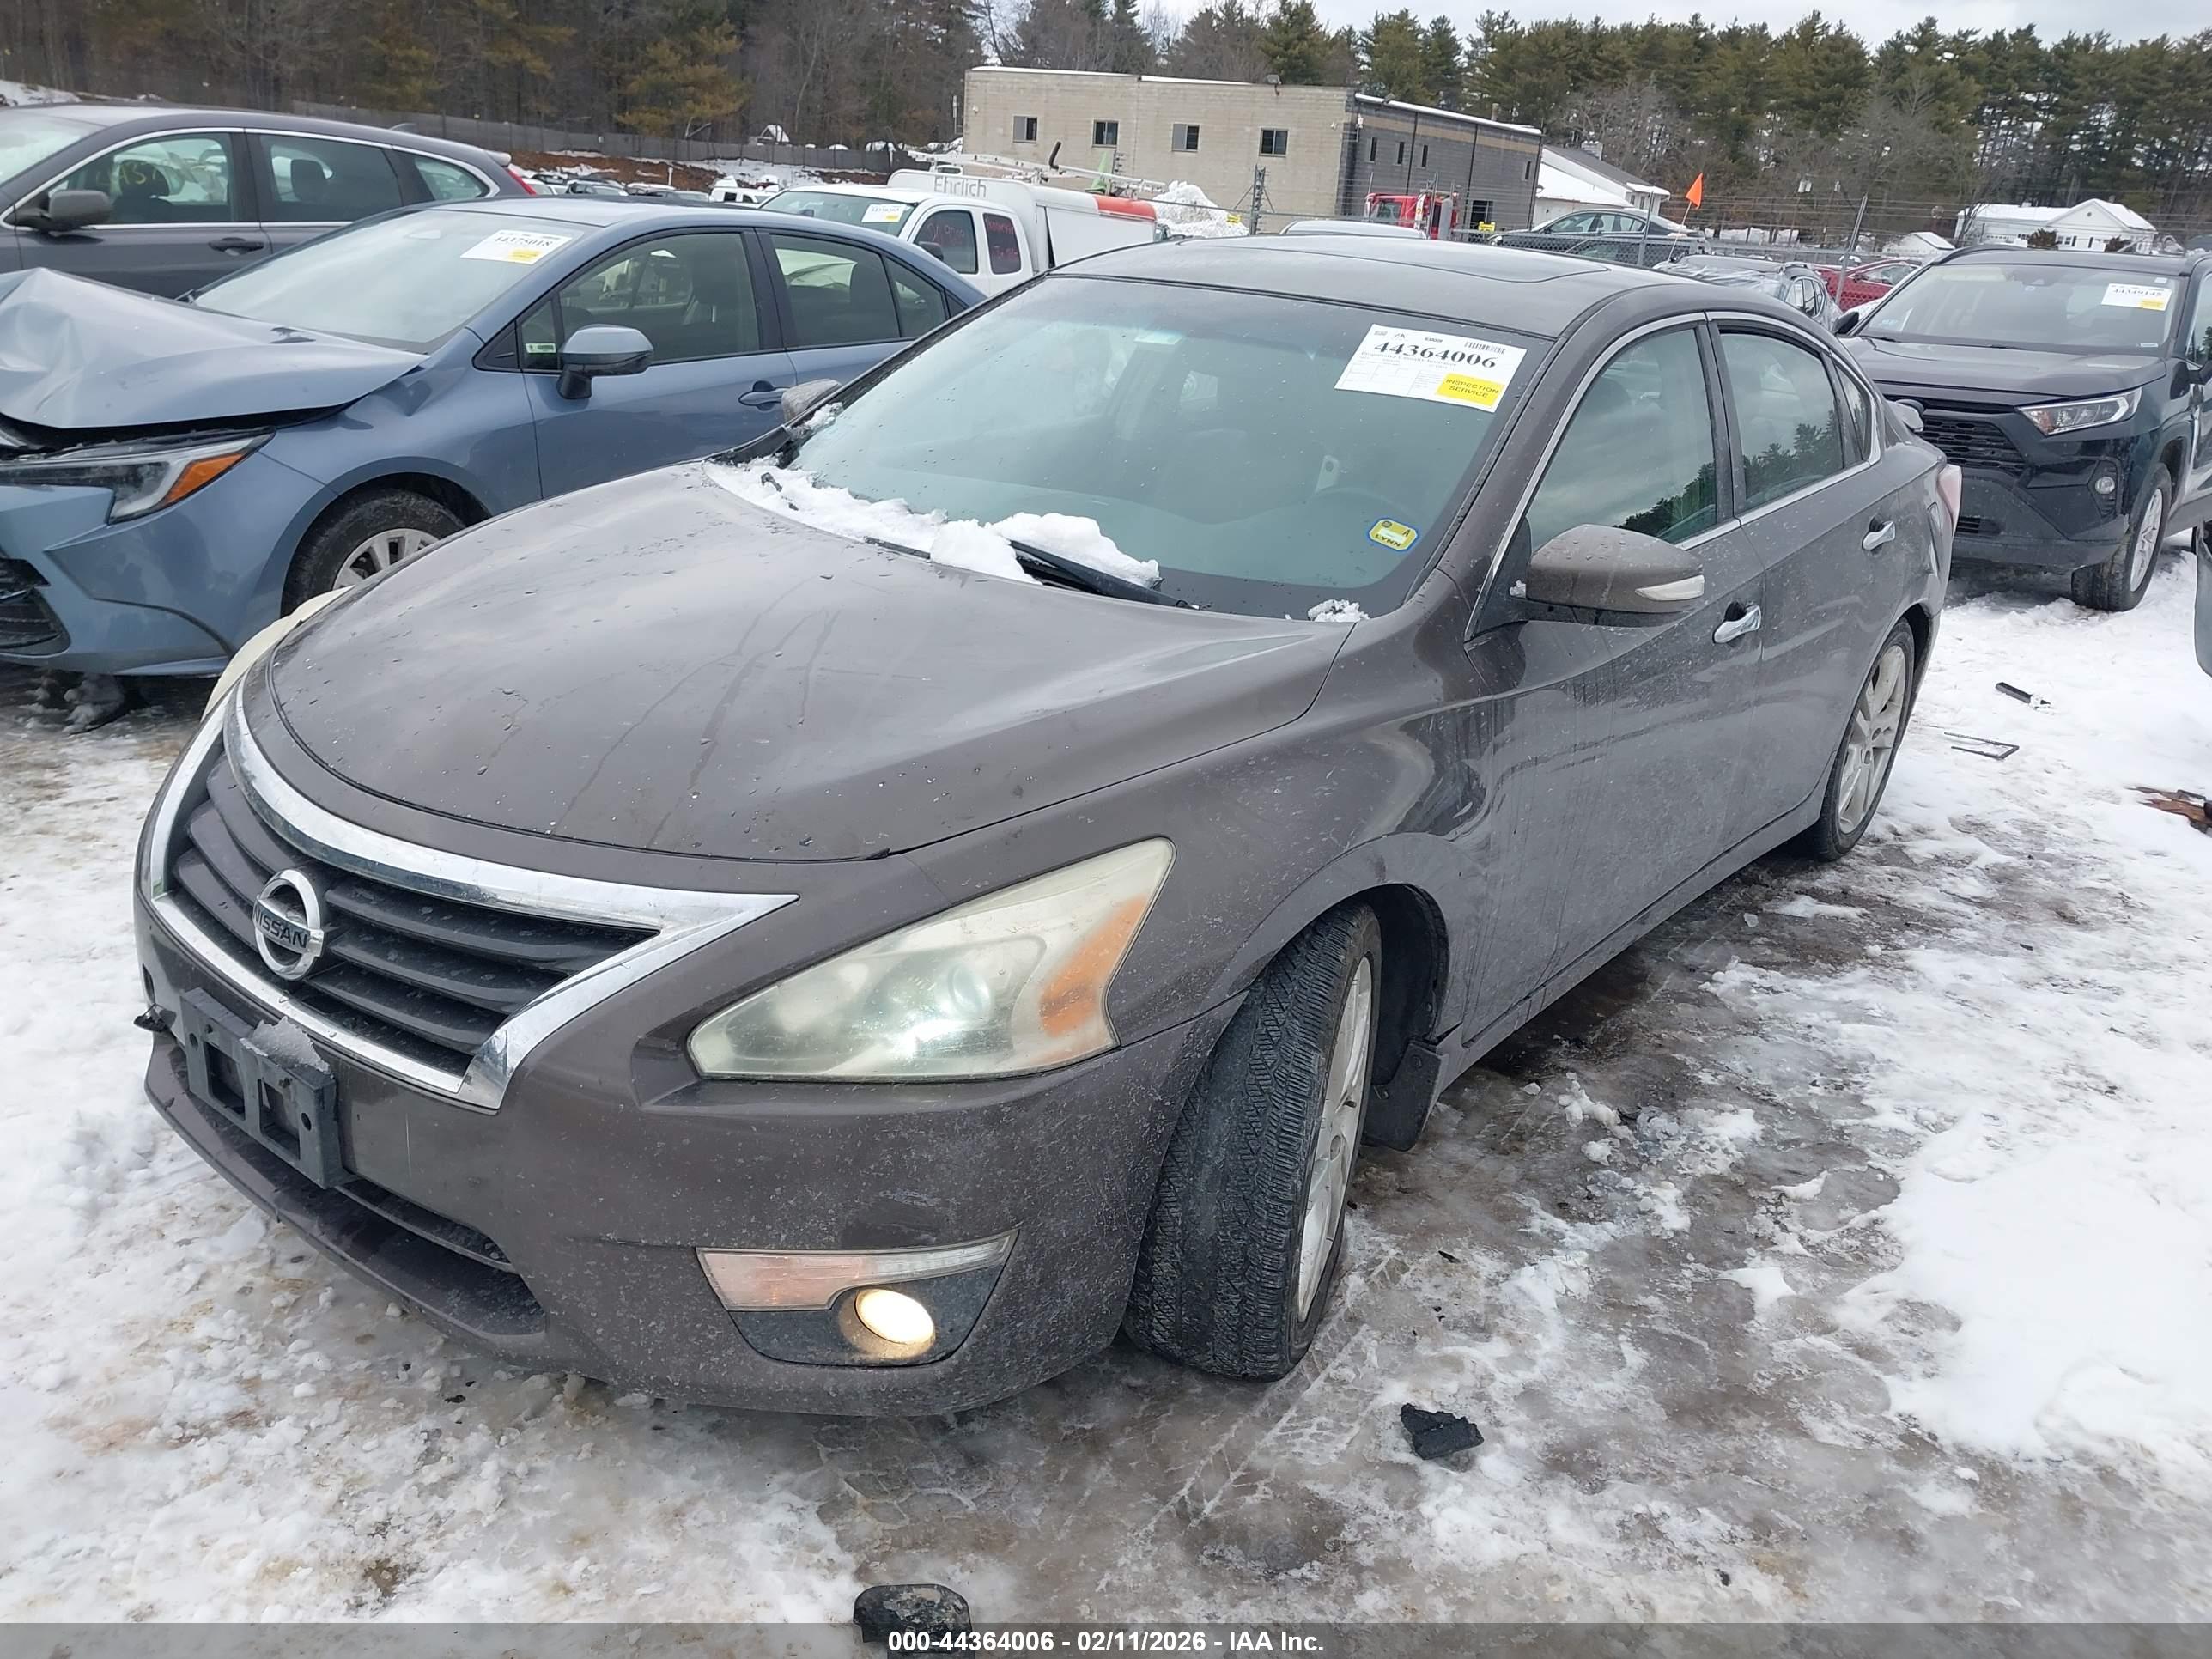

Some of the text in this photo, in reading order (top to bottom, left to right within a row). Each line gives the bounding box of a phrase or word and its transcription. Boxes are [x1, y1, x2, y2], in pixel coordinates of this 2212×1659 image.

[934, 176, 987, 198] Ehrlich
[1374, 341, 1498, 368] 44364006
[1446, 378, 1499, 394] INSPECTION
[1449, 385, 1489, 398] SERVICE
[253, 907, 308, 949] NISSAN
